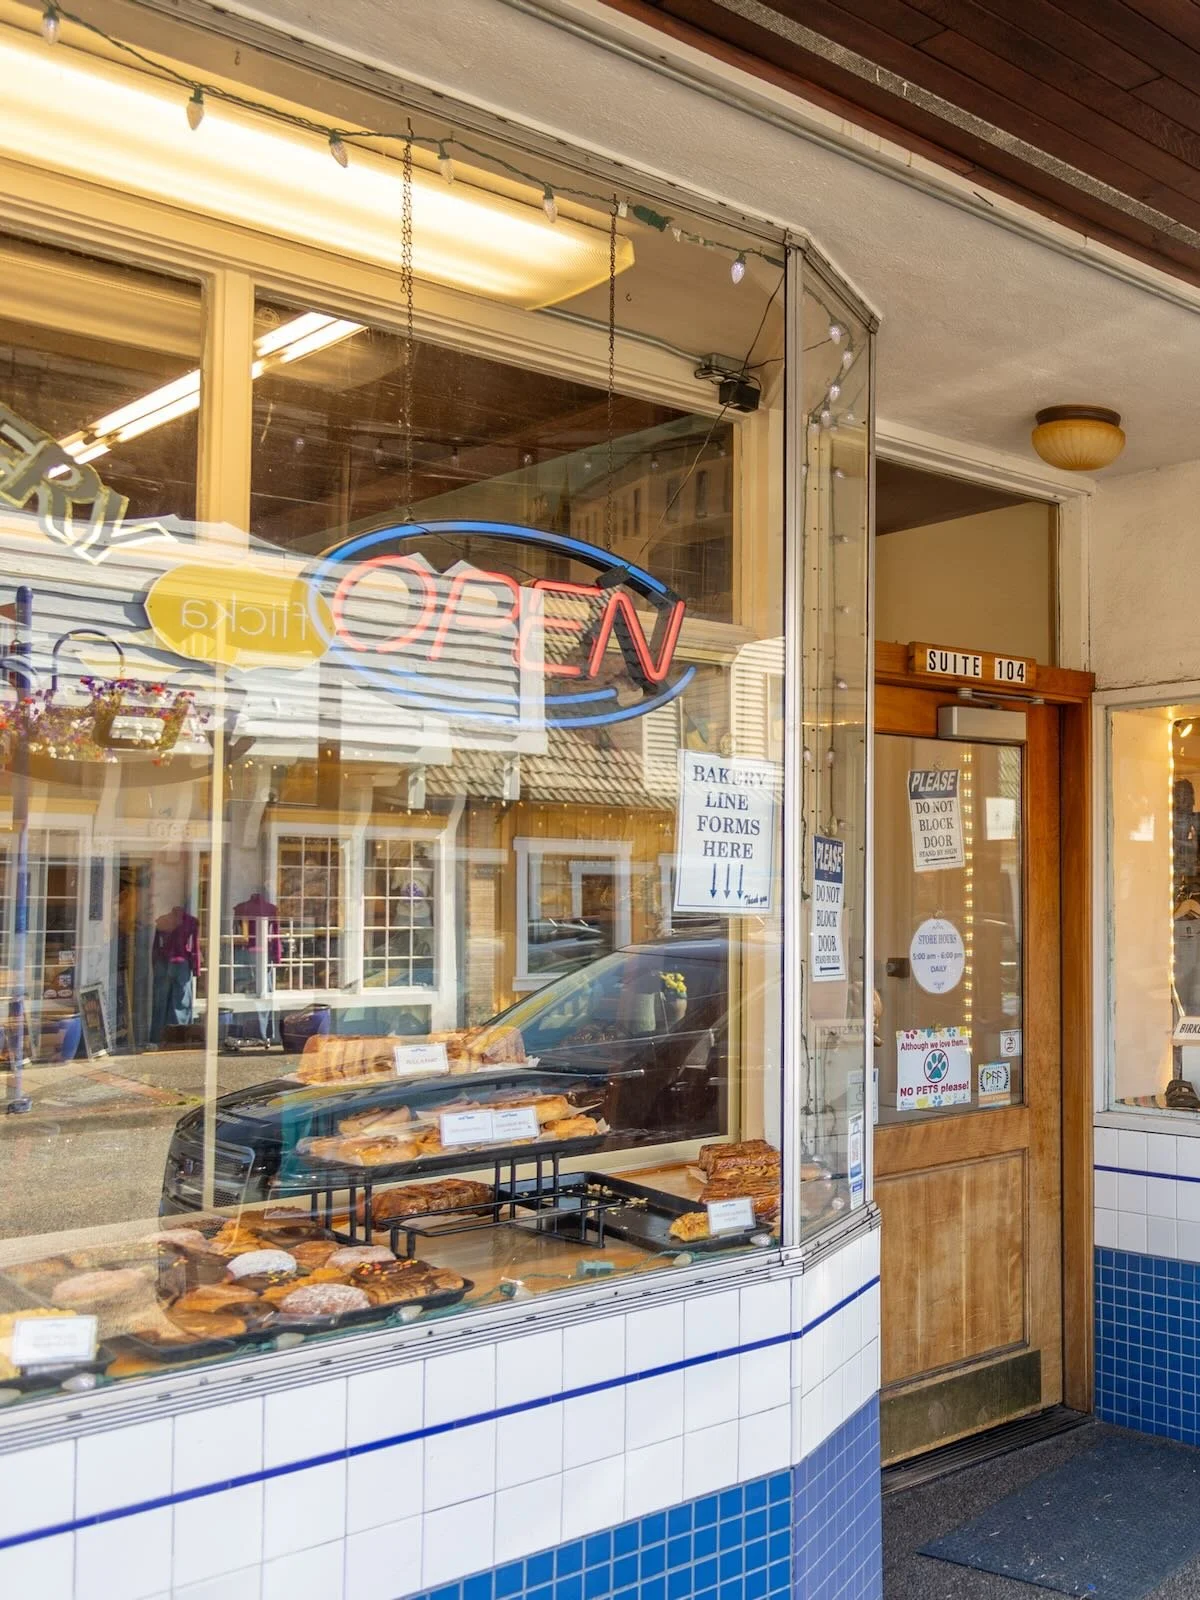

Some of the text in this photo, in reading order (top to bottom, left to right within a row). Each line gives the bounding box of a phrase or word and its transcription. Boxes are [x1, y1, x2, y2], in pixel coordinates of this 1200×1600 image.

[332, 554, 686, 684] OPEN
[928, 650, 1025, 682] SUITE 104
[692, 764, 768, 787] BAKERY
[911, 771, 957, 793] PLEASE
[705, 791, 749, 812] LINE
[915, 799, 954, 815] DO NOT
[696, 815, 761, 836] FORMS
[919, 817, 954, 832] BLOCK
[702, 839, 754, 860] HERE
[923, 835, 953, 849] DOOR
[815, 841, 843, 873] PLEASE
[919, 847, 958, 858] STAND BY SIGN
[744, 894, 768, 906] Thank you
[815, 884, 841, 904] DO NOT
[816, 909, 838, 928] BLOCK
[818, 935, 837, 952] DOOR
[918, 934, 957, 945] STORE HOURS
[953, 952, 964, 960] pm
[930, 965, 947, 973] DAILY
[900, 1041, 929, 1052] Although
[929, 1041, 939, 1049] we
[939, 1039, 951, 1048] love
[900, 1080, 969, 1097] NO PETS please!
